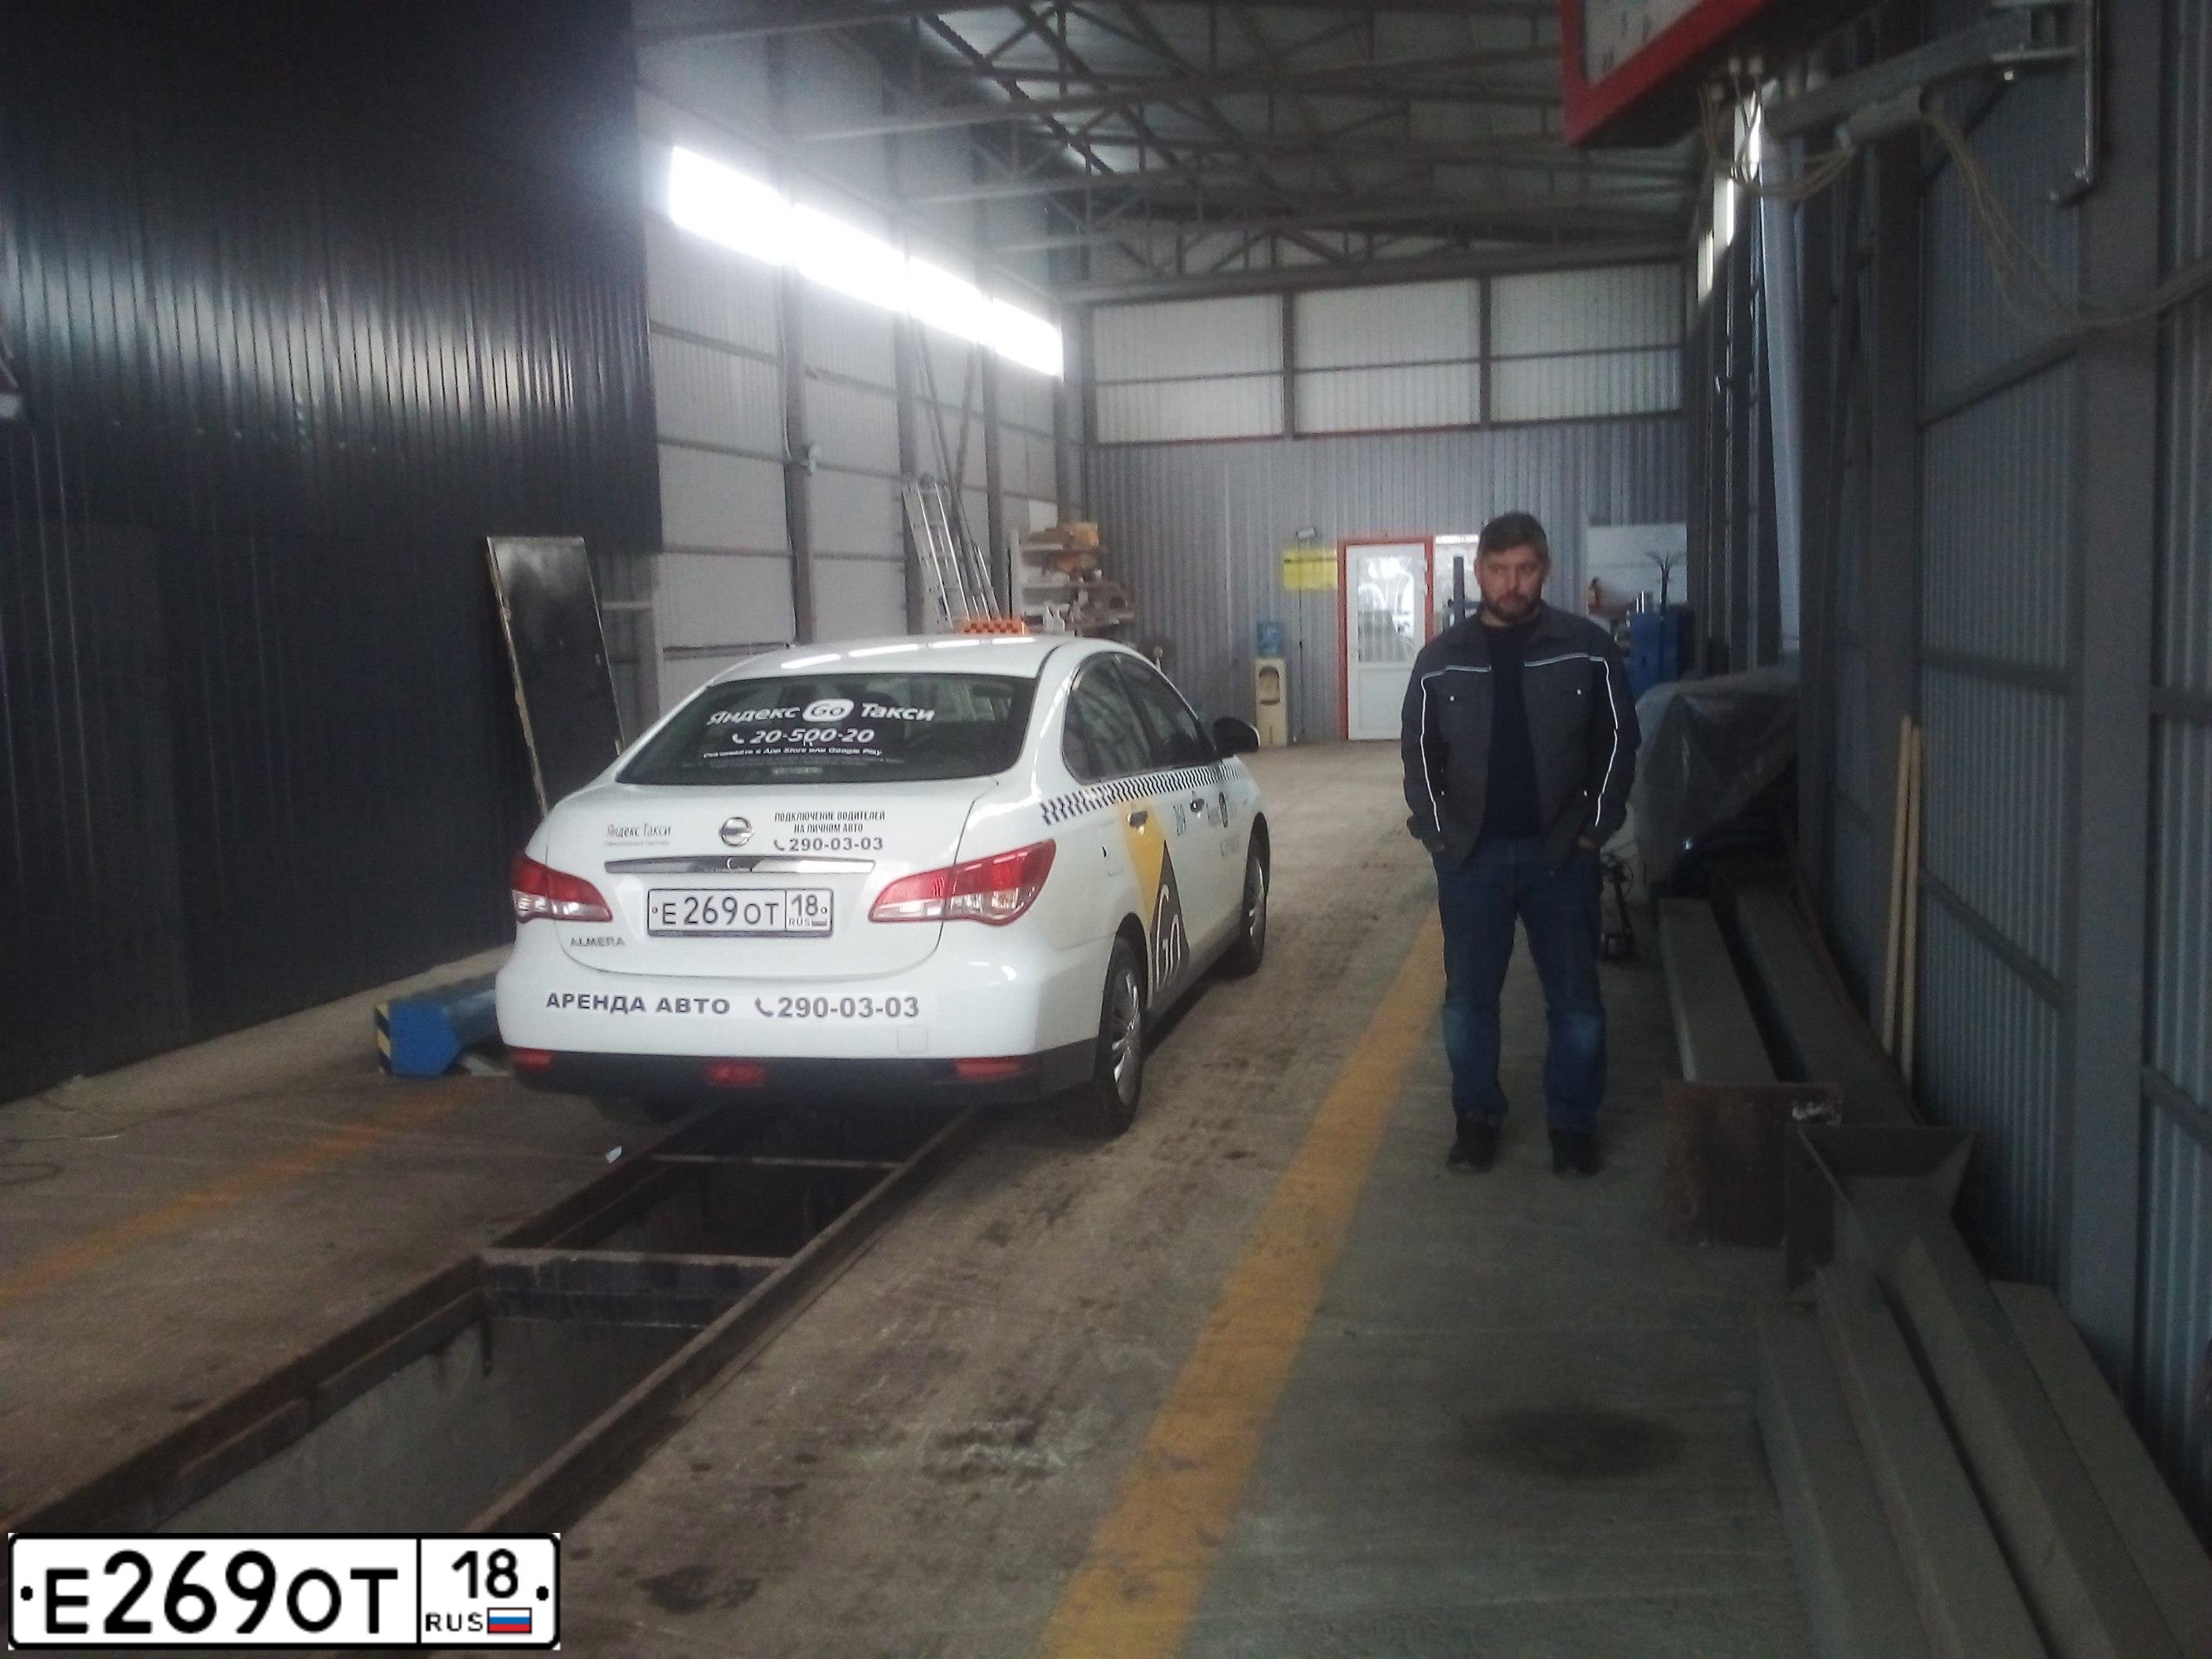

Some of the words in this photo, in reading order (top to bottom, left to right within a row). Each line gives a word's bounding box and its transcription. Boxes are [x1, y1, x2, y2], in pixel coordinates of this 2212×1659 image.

[707, 707, 800, 725] Яндекс
[860, 703, 936, 722] Такси
[775, 811, 834, 822] ПОДКЛЮЧЕНИЕ
[807, 824, 840, 833] ЛИЧНОМ
[843, 823, 863, 833] АВТО
[789, 837, 884, 851] 290-03-03
[791, 894, 819, 916] 18
[789, 917, 811, 927] RUS
[546, 993, 646, 1014] АРЕНДА
[655, 997, 731, 1015] АВТО
[777, 997, 920, 1019] 290-03-03
